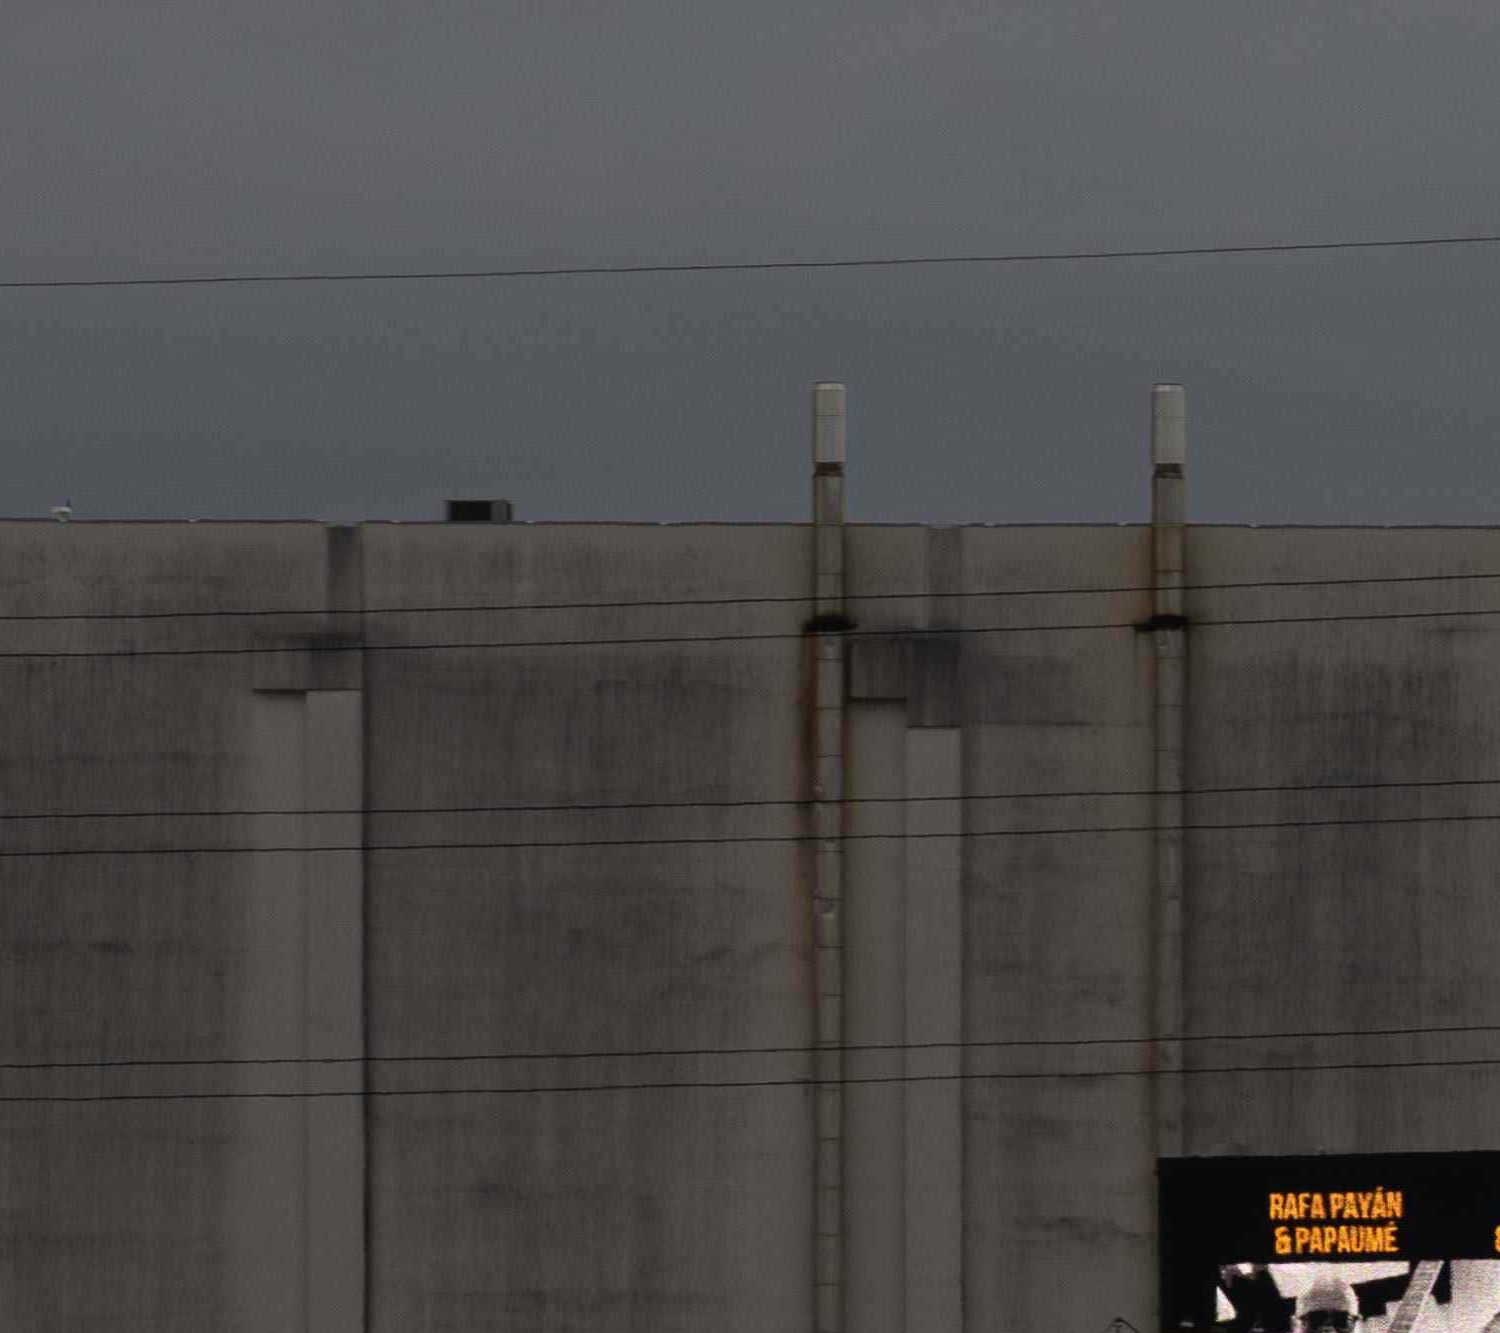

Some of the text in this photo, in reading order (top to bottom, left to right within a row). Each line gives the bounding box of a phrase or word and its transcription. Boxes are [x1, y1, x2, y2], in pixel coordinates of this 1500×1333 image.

[1269, 1187, 1403, 1220] RAFA PAYÁN
[1275, 1221, 1399, 1255] & PAPAUMÉ
